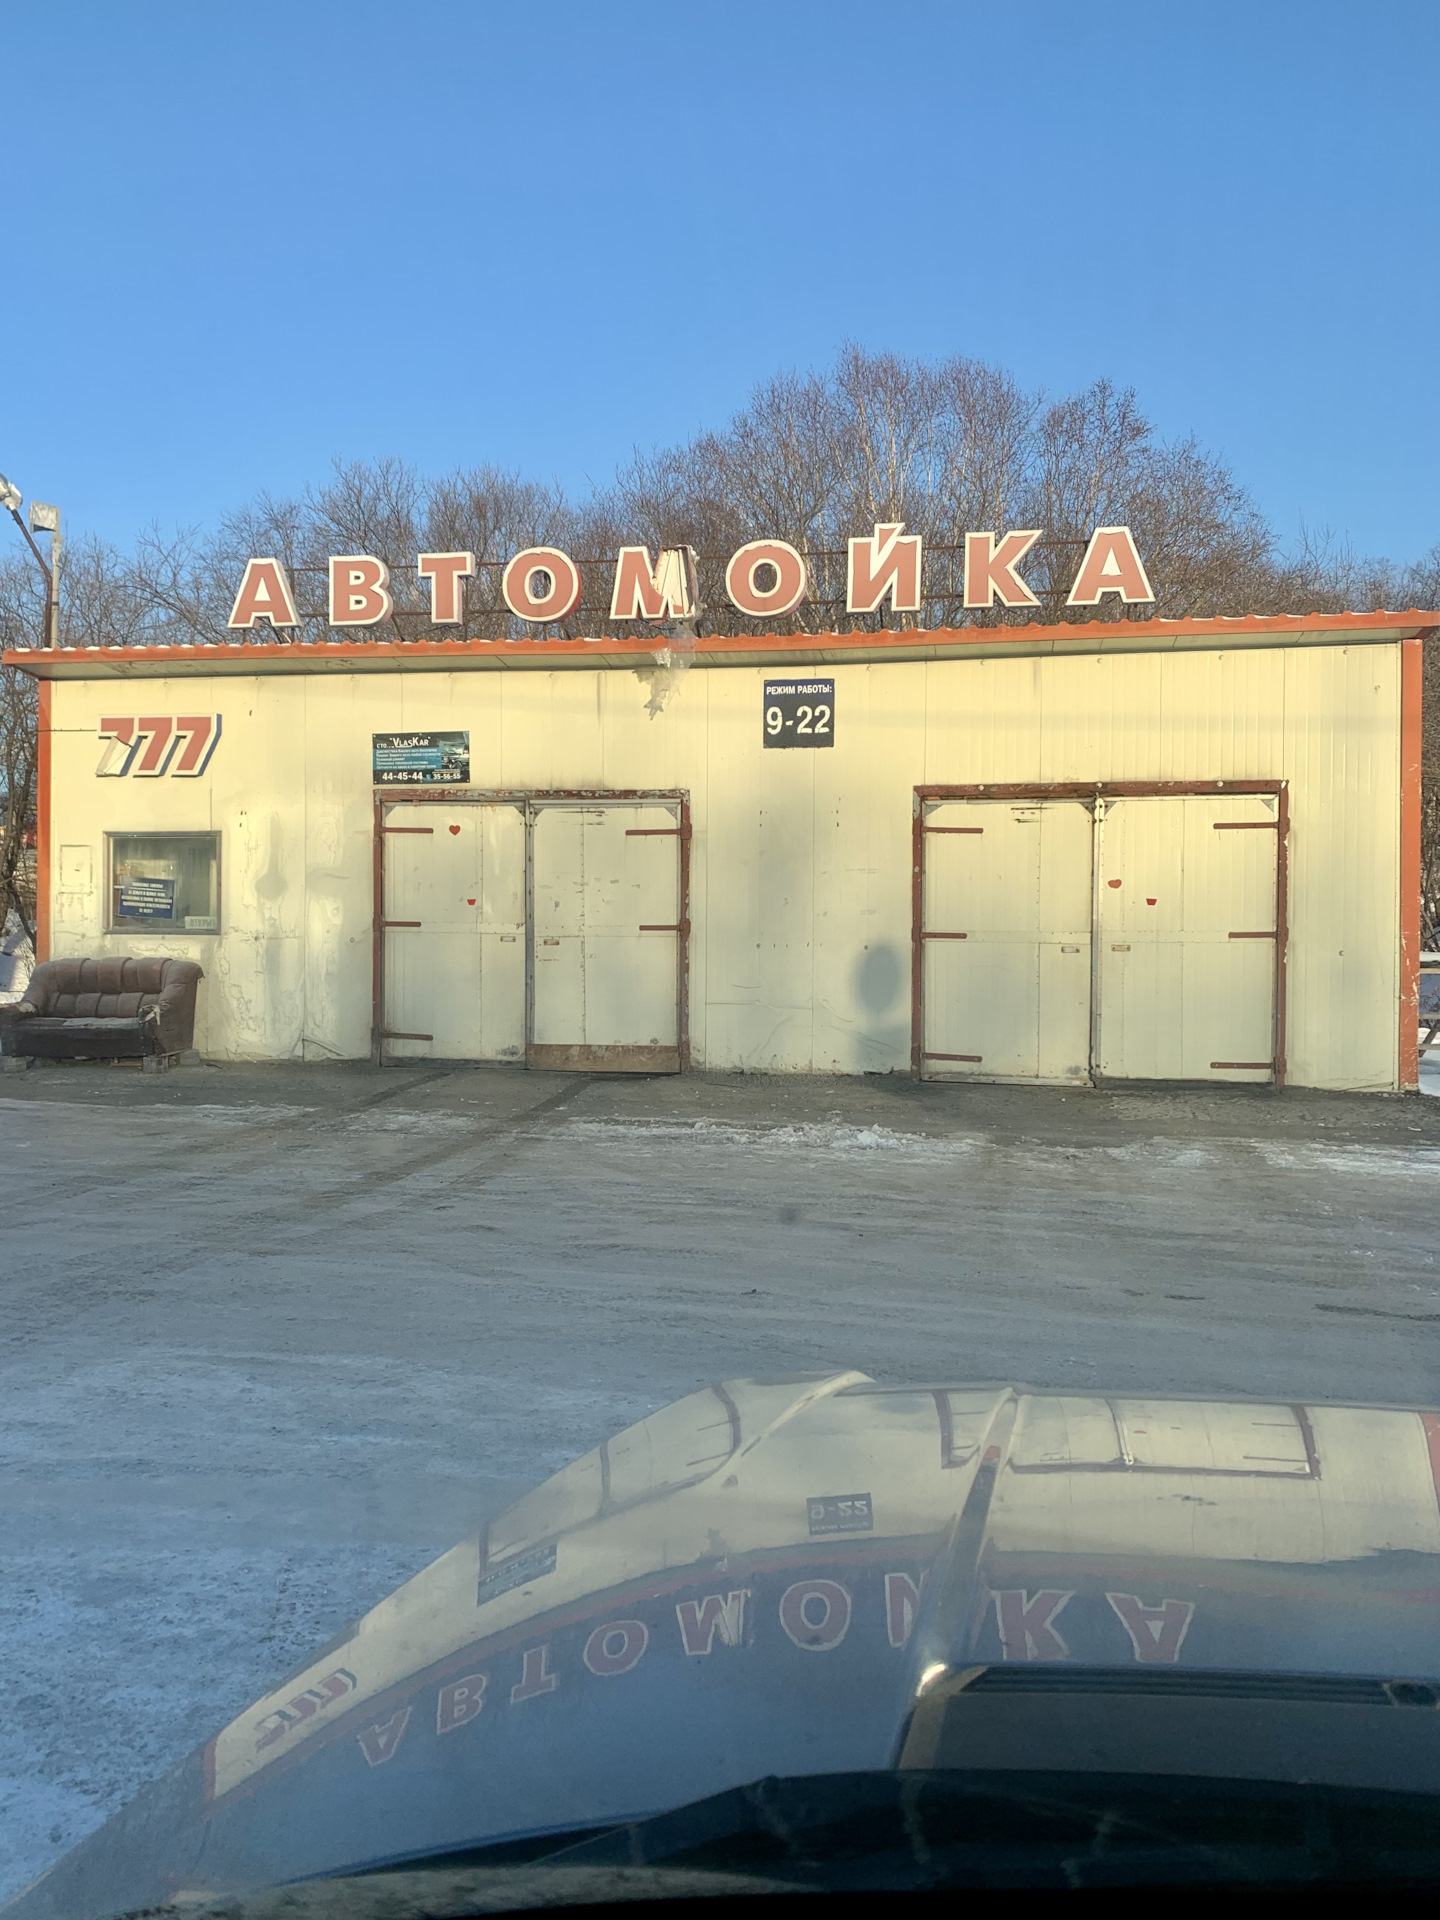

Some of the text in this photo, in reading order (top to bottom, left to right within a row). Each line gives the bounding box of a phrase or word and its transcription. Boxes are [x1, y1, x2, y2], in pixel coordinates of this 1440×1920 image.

[227, 523, 1156, 629] АВТОМОЙКА
[766, 684, 833, 695] РЕЖИМ РАБОТЫ:
[766, 705, 831, 735] 9-22
[95, 713, 222, 778] 777
[382, 771, 423, 780] 44-45-44
